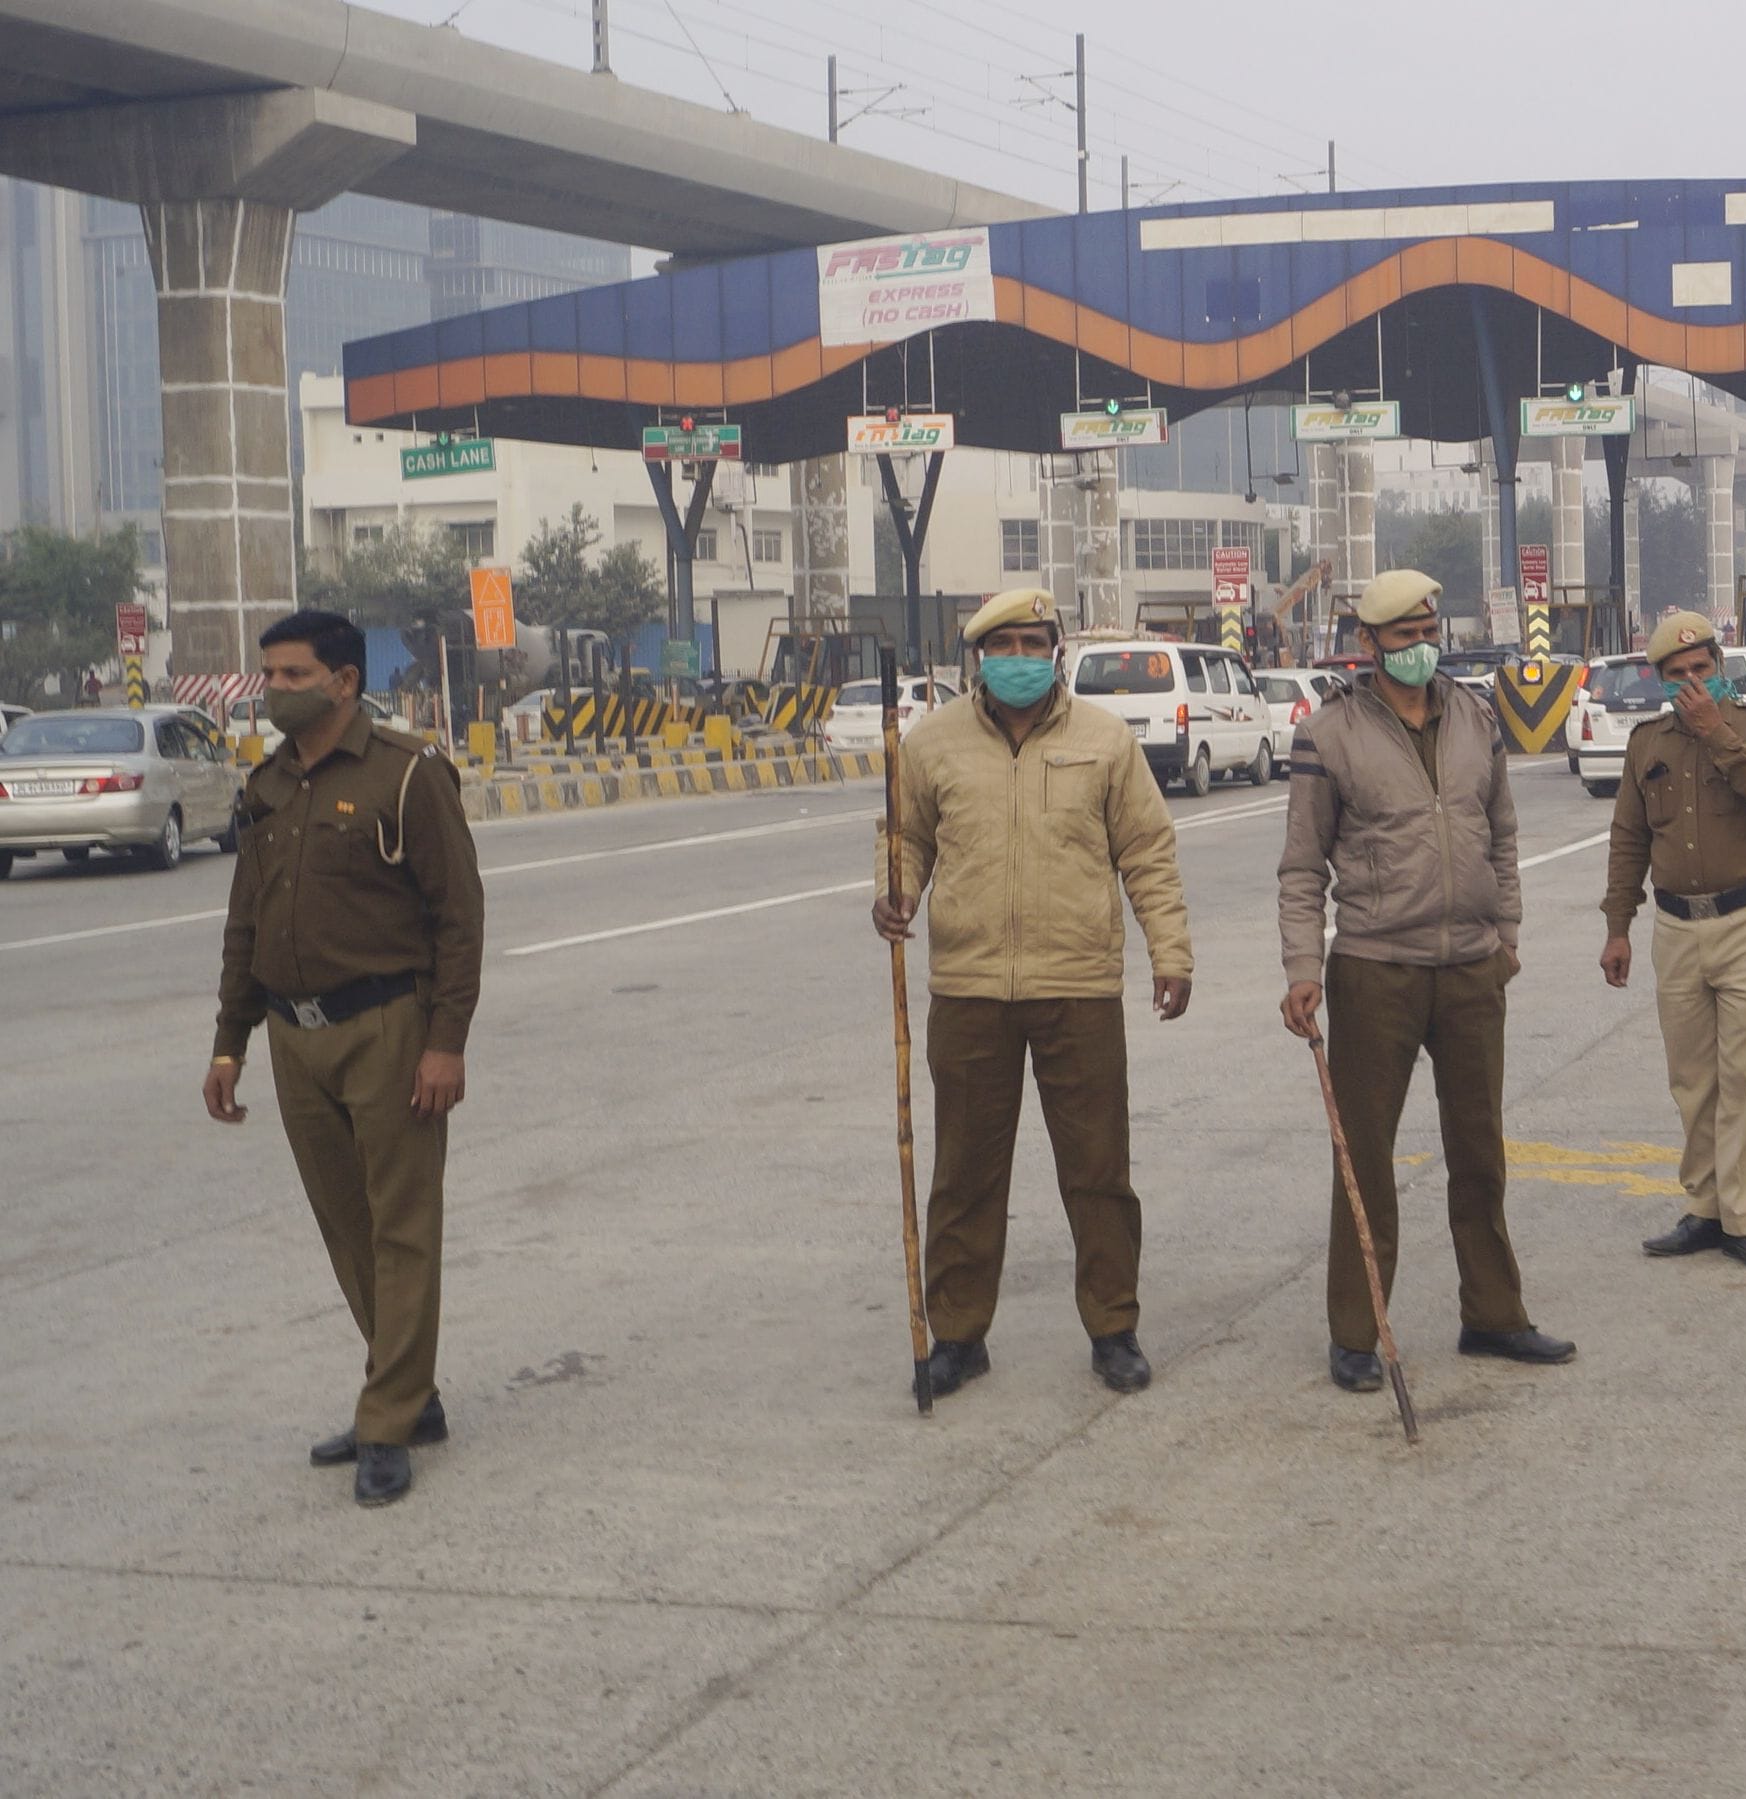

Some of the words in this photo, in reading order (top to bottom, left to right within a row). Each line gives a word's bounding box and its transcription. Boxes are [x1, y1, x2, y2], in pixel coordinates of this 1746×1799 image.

[868, 282, 966, 304] EXPRESS
[405, 452, 446, 474] CASH
[450, 447, 490, 469] LANE
[1215, 550, 1248, 559] CAUTION
